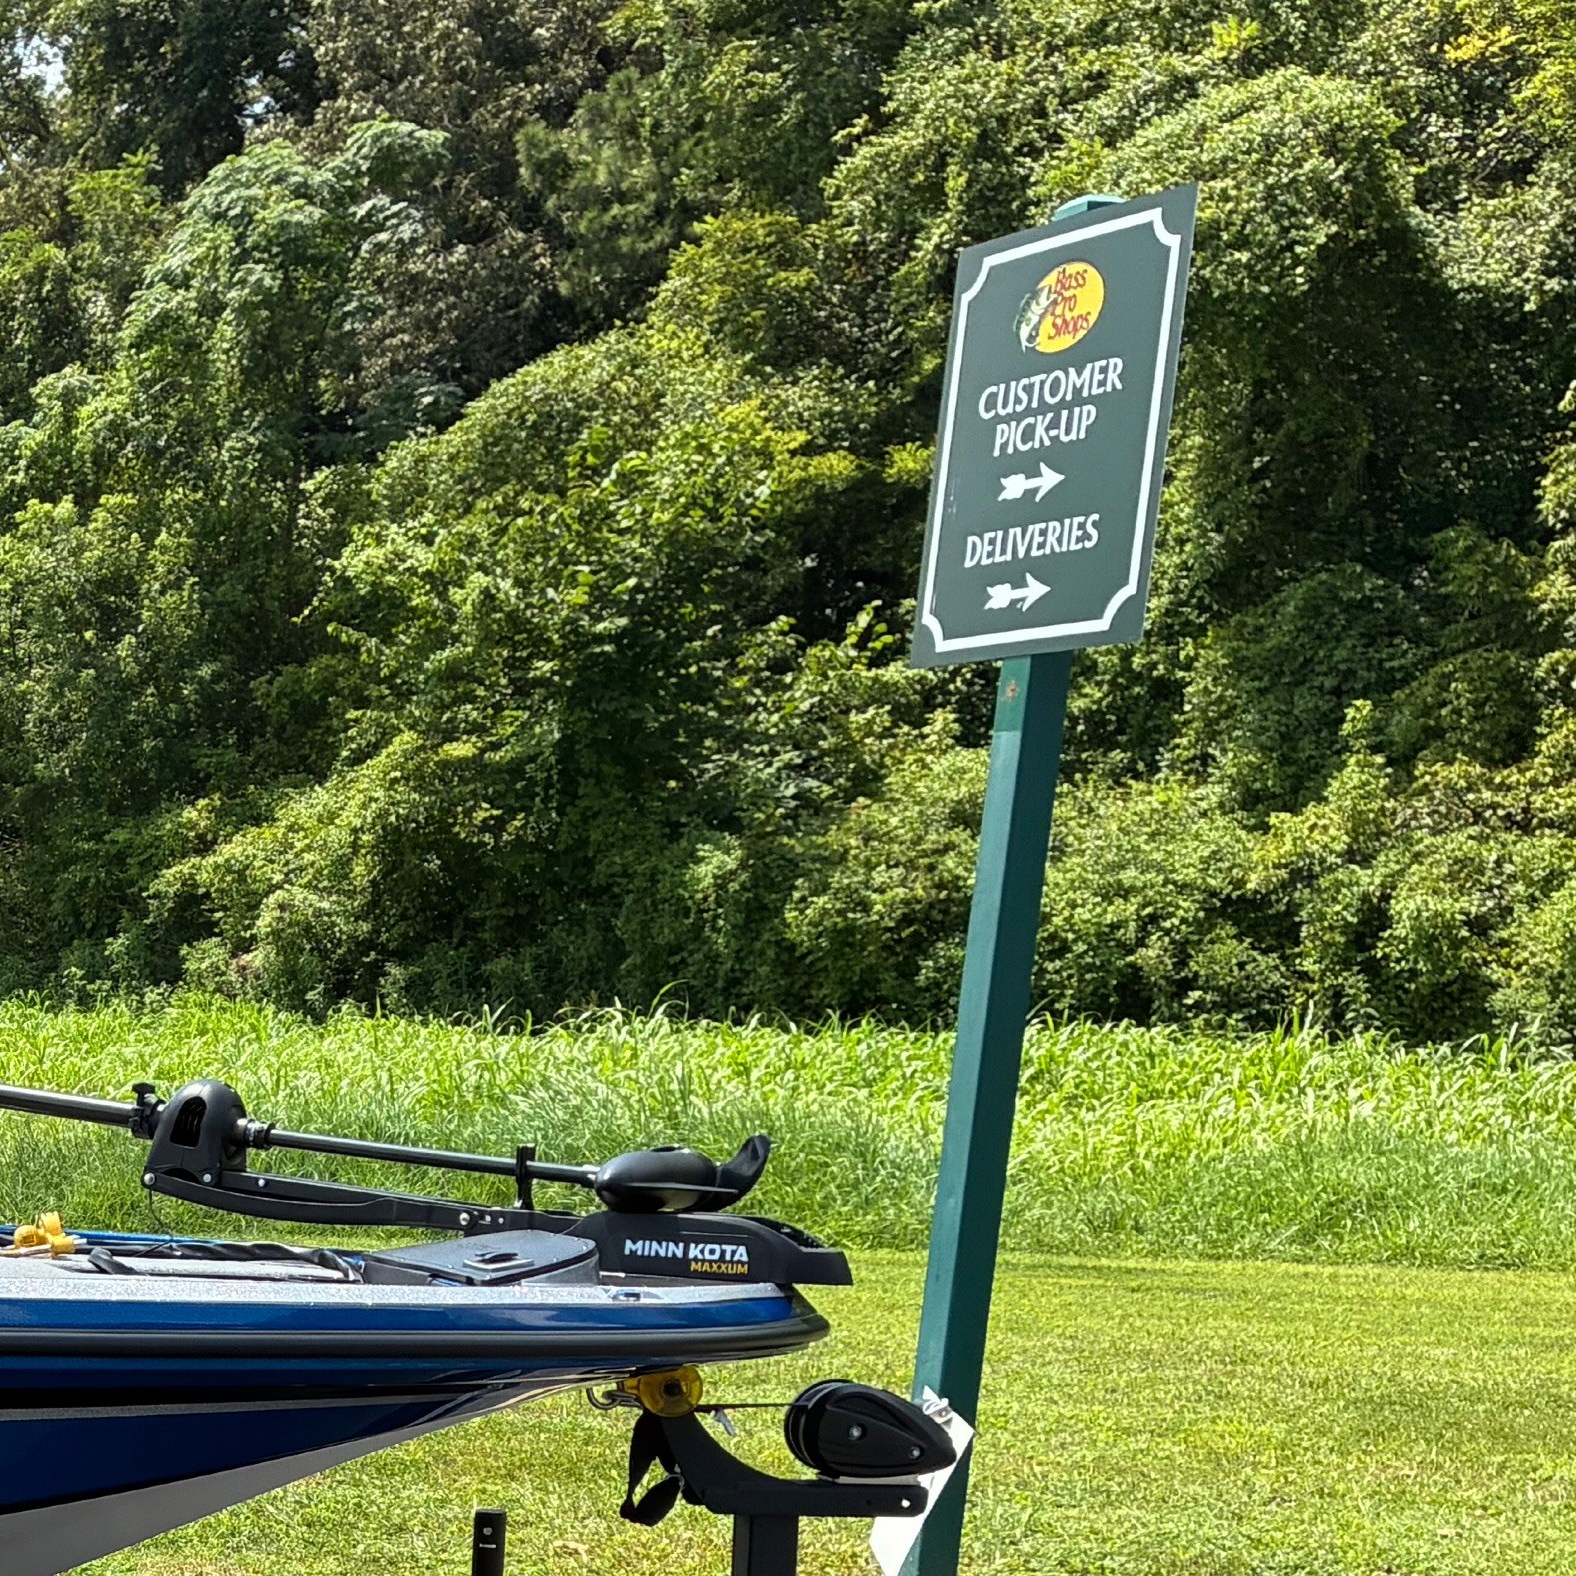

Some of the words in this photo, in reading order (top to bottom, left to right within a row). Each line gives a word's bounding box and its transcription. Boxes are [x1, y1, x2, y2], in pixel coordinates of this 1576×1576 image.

[1054, 266, 1088, 296] Bass
[1050, 293, 1078, 318] Pro
[1047, 310, 1092, 341] Shops
[978, 356, 1124, 421] CUSTOMER
[992, 402, 1097, 458] PICK-UP
[963, 512, 1101, 569] DELIVERIES
[624, 1237, 684, 1259] MINN
[687, 1241, 749, 1261] KOTA
[690, 1260, 749, 1275] MAXXUM
